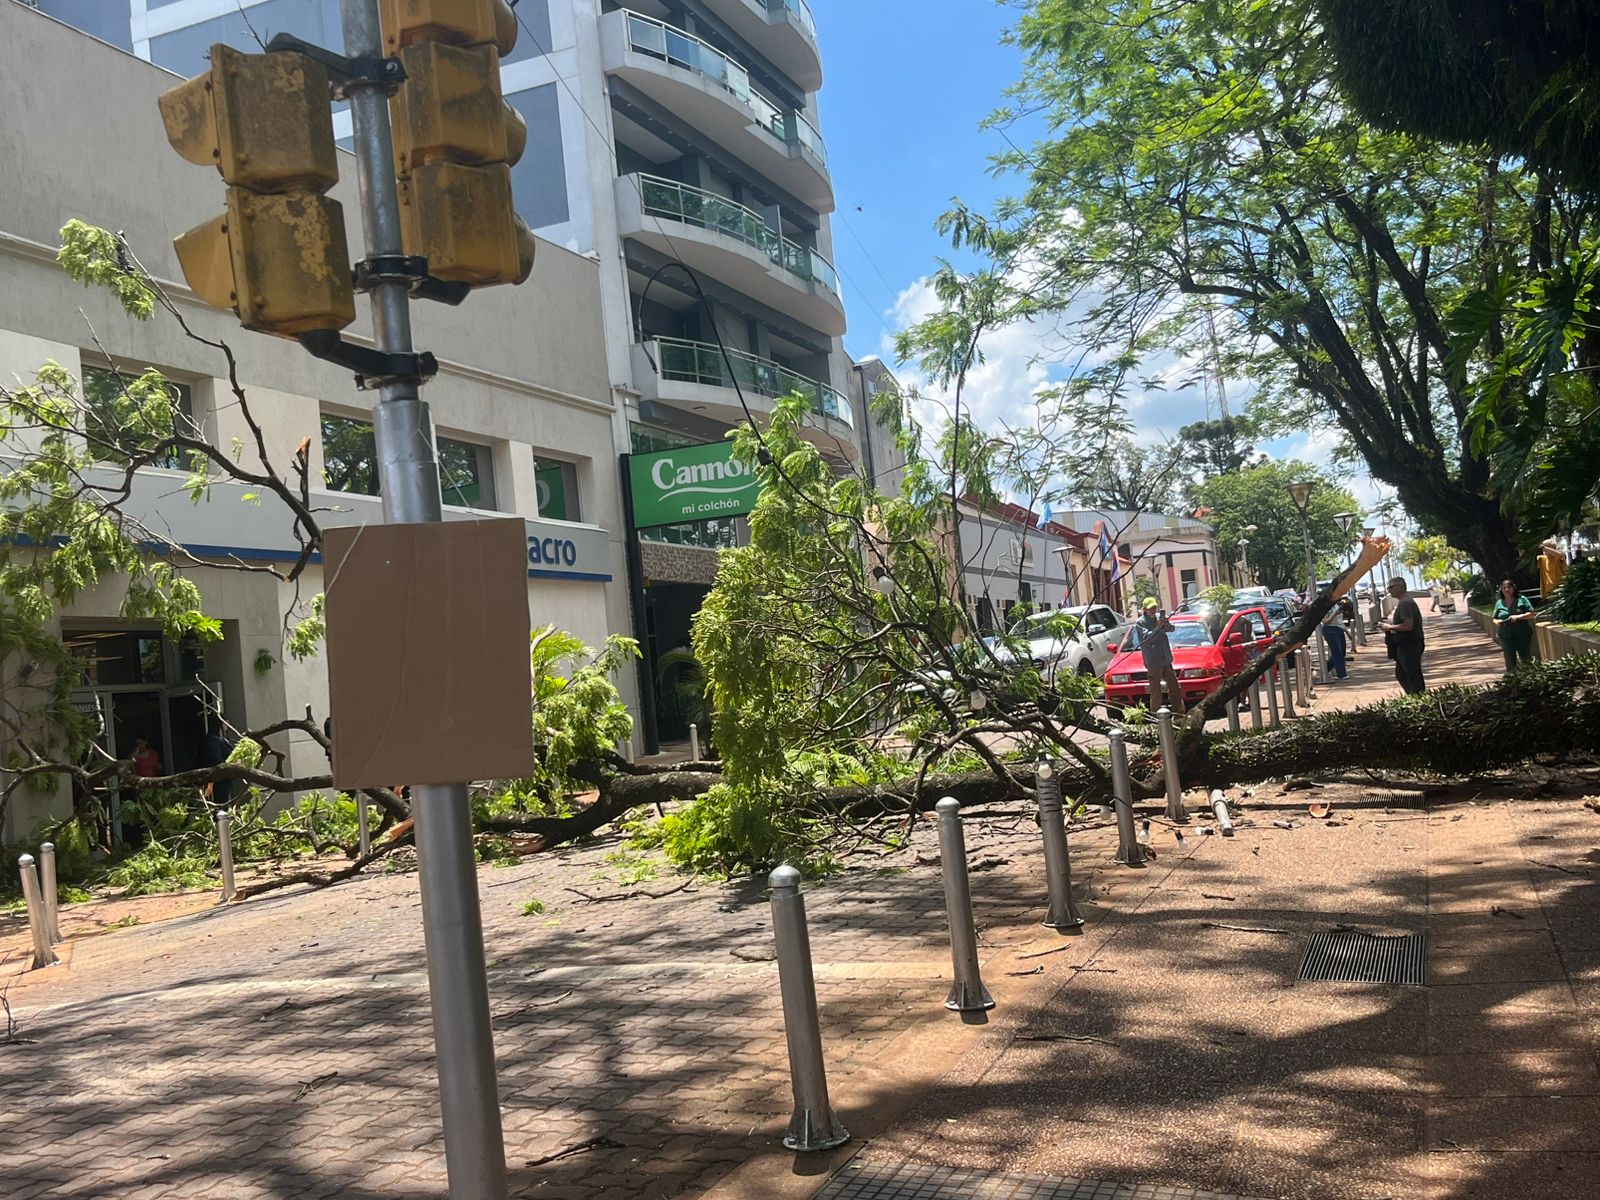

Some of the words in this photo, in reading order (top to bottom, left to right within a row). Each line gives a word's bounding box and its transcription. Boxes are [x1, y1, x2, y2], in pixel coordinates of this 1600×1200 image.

[682, 503, 695, 514] mi
[698, 498, 740, 512] colchón
[528, 536, 576, 566] acro
